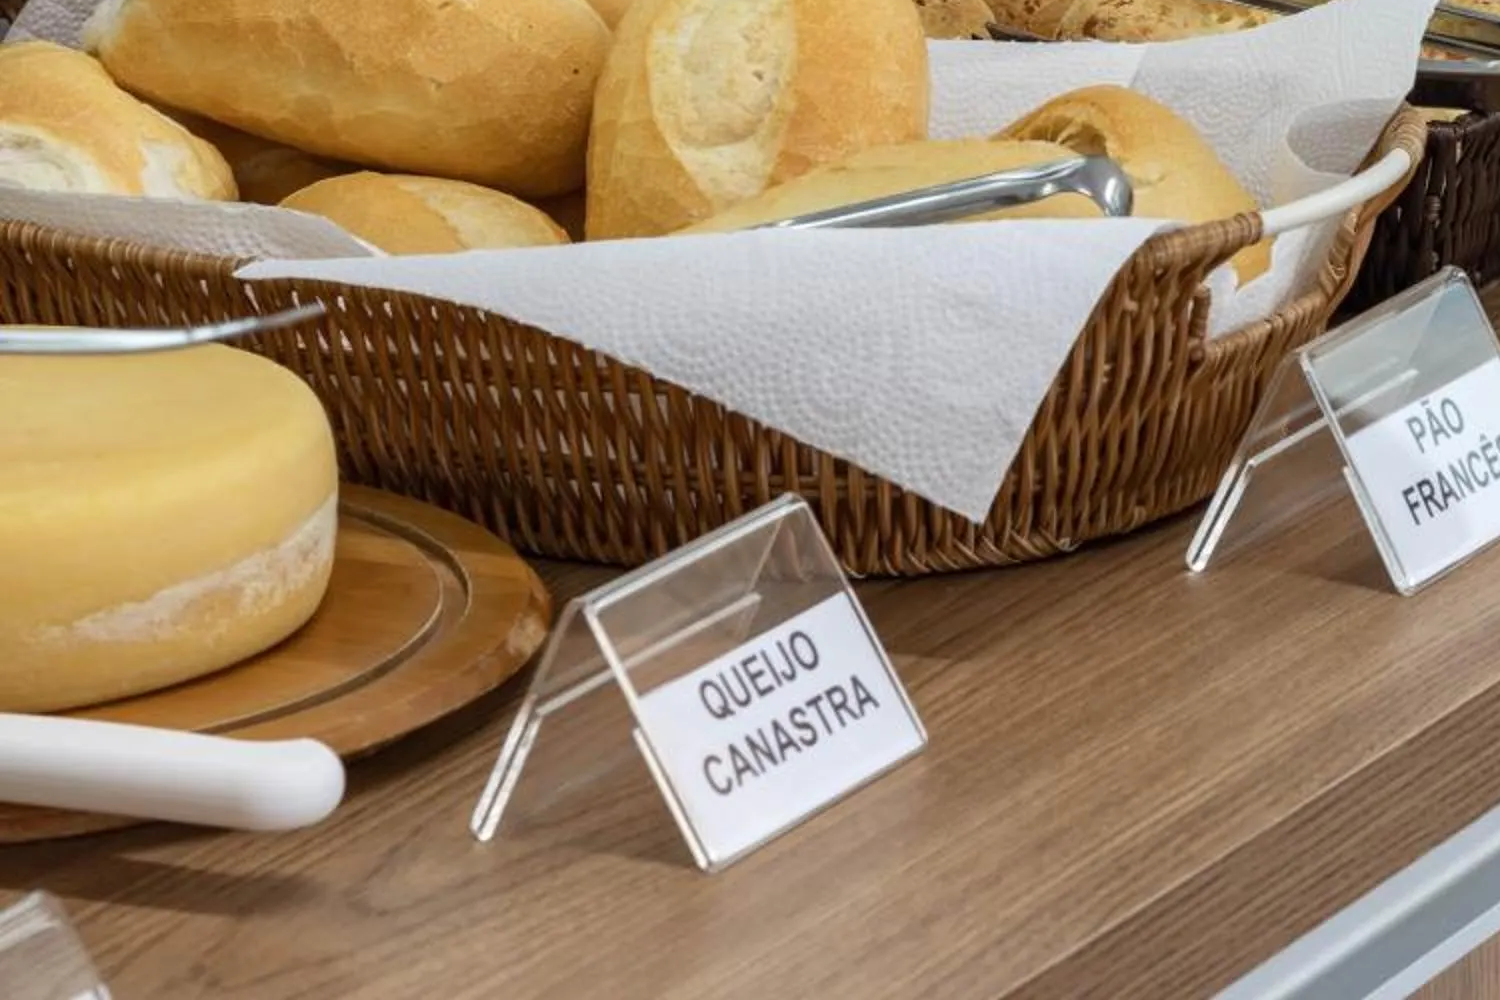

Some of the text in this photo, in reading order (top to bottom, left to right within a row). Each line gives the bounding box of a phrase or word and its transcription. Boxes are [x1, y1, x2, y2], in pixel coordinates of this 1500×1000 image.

[1405, 397, 1465, 453] PÃO
[699, 629, 820, 720] QUEIJO
[703, 675, 880, 796] CANASTRA
